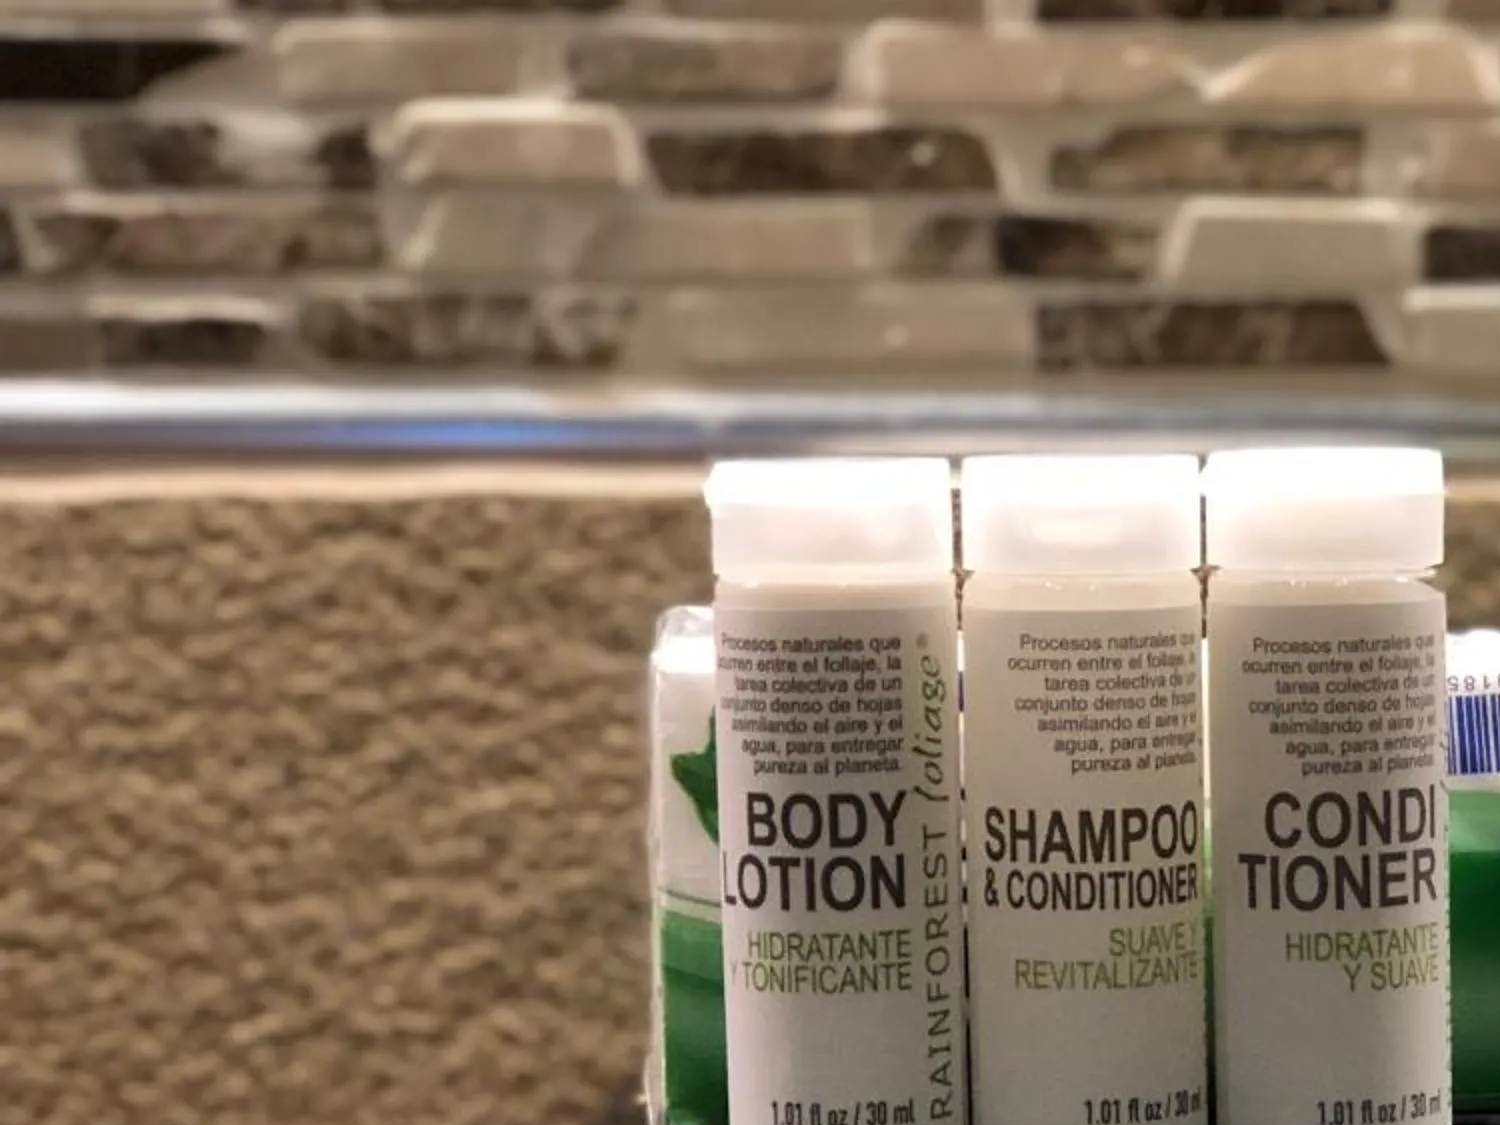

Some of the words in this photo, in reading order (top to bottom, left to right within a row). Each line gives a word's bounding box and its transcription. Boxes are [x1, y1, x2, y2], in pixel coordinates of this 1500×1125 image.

[782, 635, 864, 651] naturales
[869, 637, 901, 653] que
[1020, 634, 1102, 651] Procesos
[1253, 637, 1332, 653] Procesos
[1337, 635, 1412, 653] naturales
[757, 658, 797, 672] entre
[802, 656, 818, 672] el
[887, 656, 902, 670] la
[1008, 657, 1071, 671] ocurren
[1077, 656, 1122, 671] entre
[1129, 654, 1142, 669] el
[1242, 658, 1302, 674] ocurren
[1307, 657, 1353, 674] entre
[1359, 656, 1373, 672] el
[772, 676, 848, 693] colectiva
[854, 675, 876, 691] de
[881, 678, 902, 690] un
[1044, 676, 1090, 691] tarea
[1095, 674, 1165, 690] colectiva
[1276, 678, 1320, 694] tarea
[1326, 678, 1398, 694] colectiva
[771, 697, 823, 713] denso
[828, 698, 850, 712] de
[857, 697, 902, 716] hojas
[1015, 696, 1088, 715] conjunto
[1093, 696, 1146, 711] denso
[1151, 692, 1168, 708] de
[1248, 699, 1318, 717] conjunto
[1323, 698, 1377, 713] denso
[1382, 695, 1400, 711] de
[813, 718, 829, 734] el
[834, 719, 868, 733] aire
[888, 719, 903, 729] el
[1037, 716, 1132, 731] asimilando
[1137, 714, 1150, 729] el
[1269, 718, 1363, 734] asimilando
[1369, 717, 1383, 732] el
[786, 741, 825, 756] para
[831, 738, 904, 755] entregar
[1110, 737, 1147, 753] para
[1340, 738, 1379, 756] para
[754, 760, 807, 776] pureza
[813, 758, 829, 773] al
[1071, 757, 1132, 775] pureza
[1136, 754, 1150, 770] al
[1302, 759, 1363, 777] pureza
[1368, 756, 1383, 772] al
[747, 791, 907, 849] BODY
[1264, 783, 1435, 849] CONDI
[985, 800, 1198, 864] SHAMPOO
[723, 852, 906, 912] LOTION
[984, 867, 999, 908] &
[1006, 863, 1198, 911] CONDITIONER
[1238, 848, 1438, 912] TIONER
[747, 928, 913, 963] HIDRATANTE
[1109, 921, 1187, 957] SUAVE
[1286, 922, 1439, 963] HIDRATANTE
[743, 961, 913, 995] TONIFICANTE
[922, 824, 954, 1120] RAINFOREST
[1015, 952, 1198, 990] REVITALIZANTE
[1344, 963, 1361, 992] Y
[1370, 954, 1439, 991] SUAVE
[893, 1099, 915, 1125] ml
[1084, 1097, 1120, 1125] 1.01
[1128, 1097, 1139, 1123] fl
[1145, 1103, 1162, 1121] oz
[1317, 1100, 1353, 1125] 1.01
[1361, 1098, 1373, 1125] fl
[1378, 1103, 1397, 1123] oz
[1411, 1092, 1427, 1119] 30
